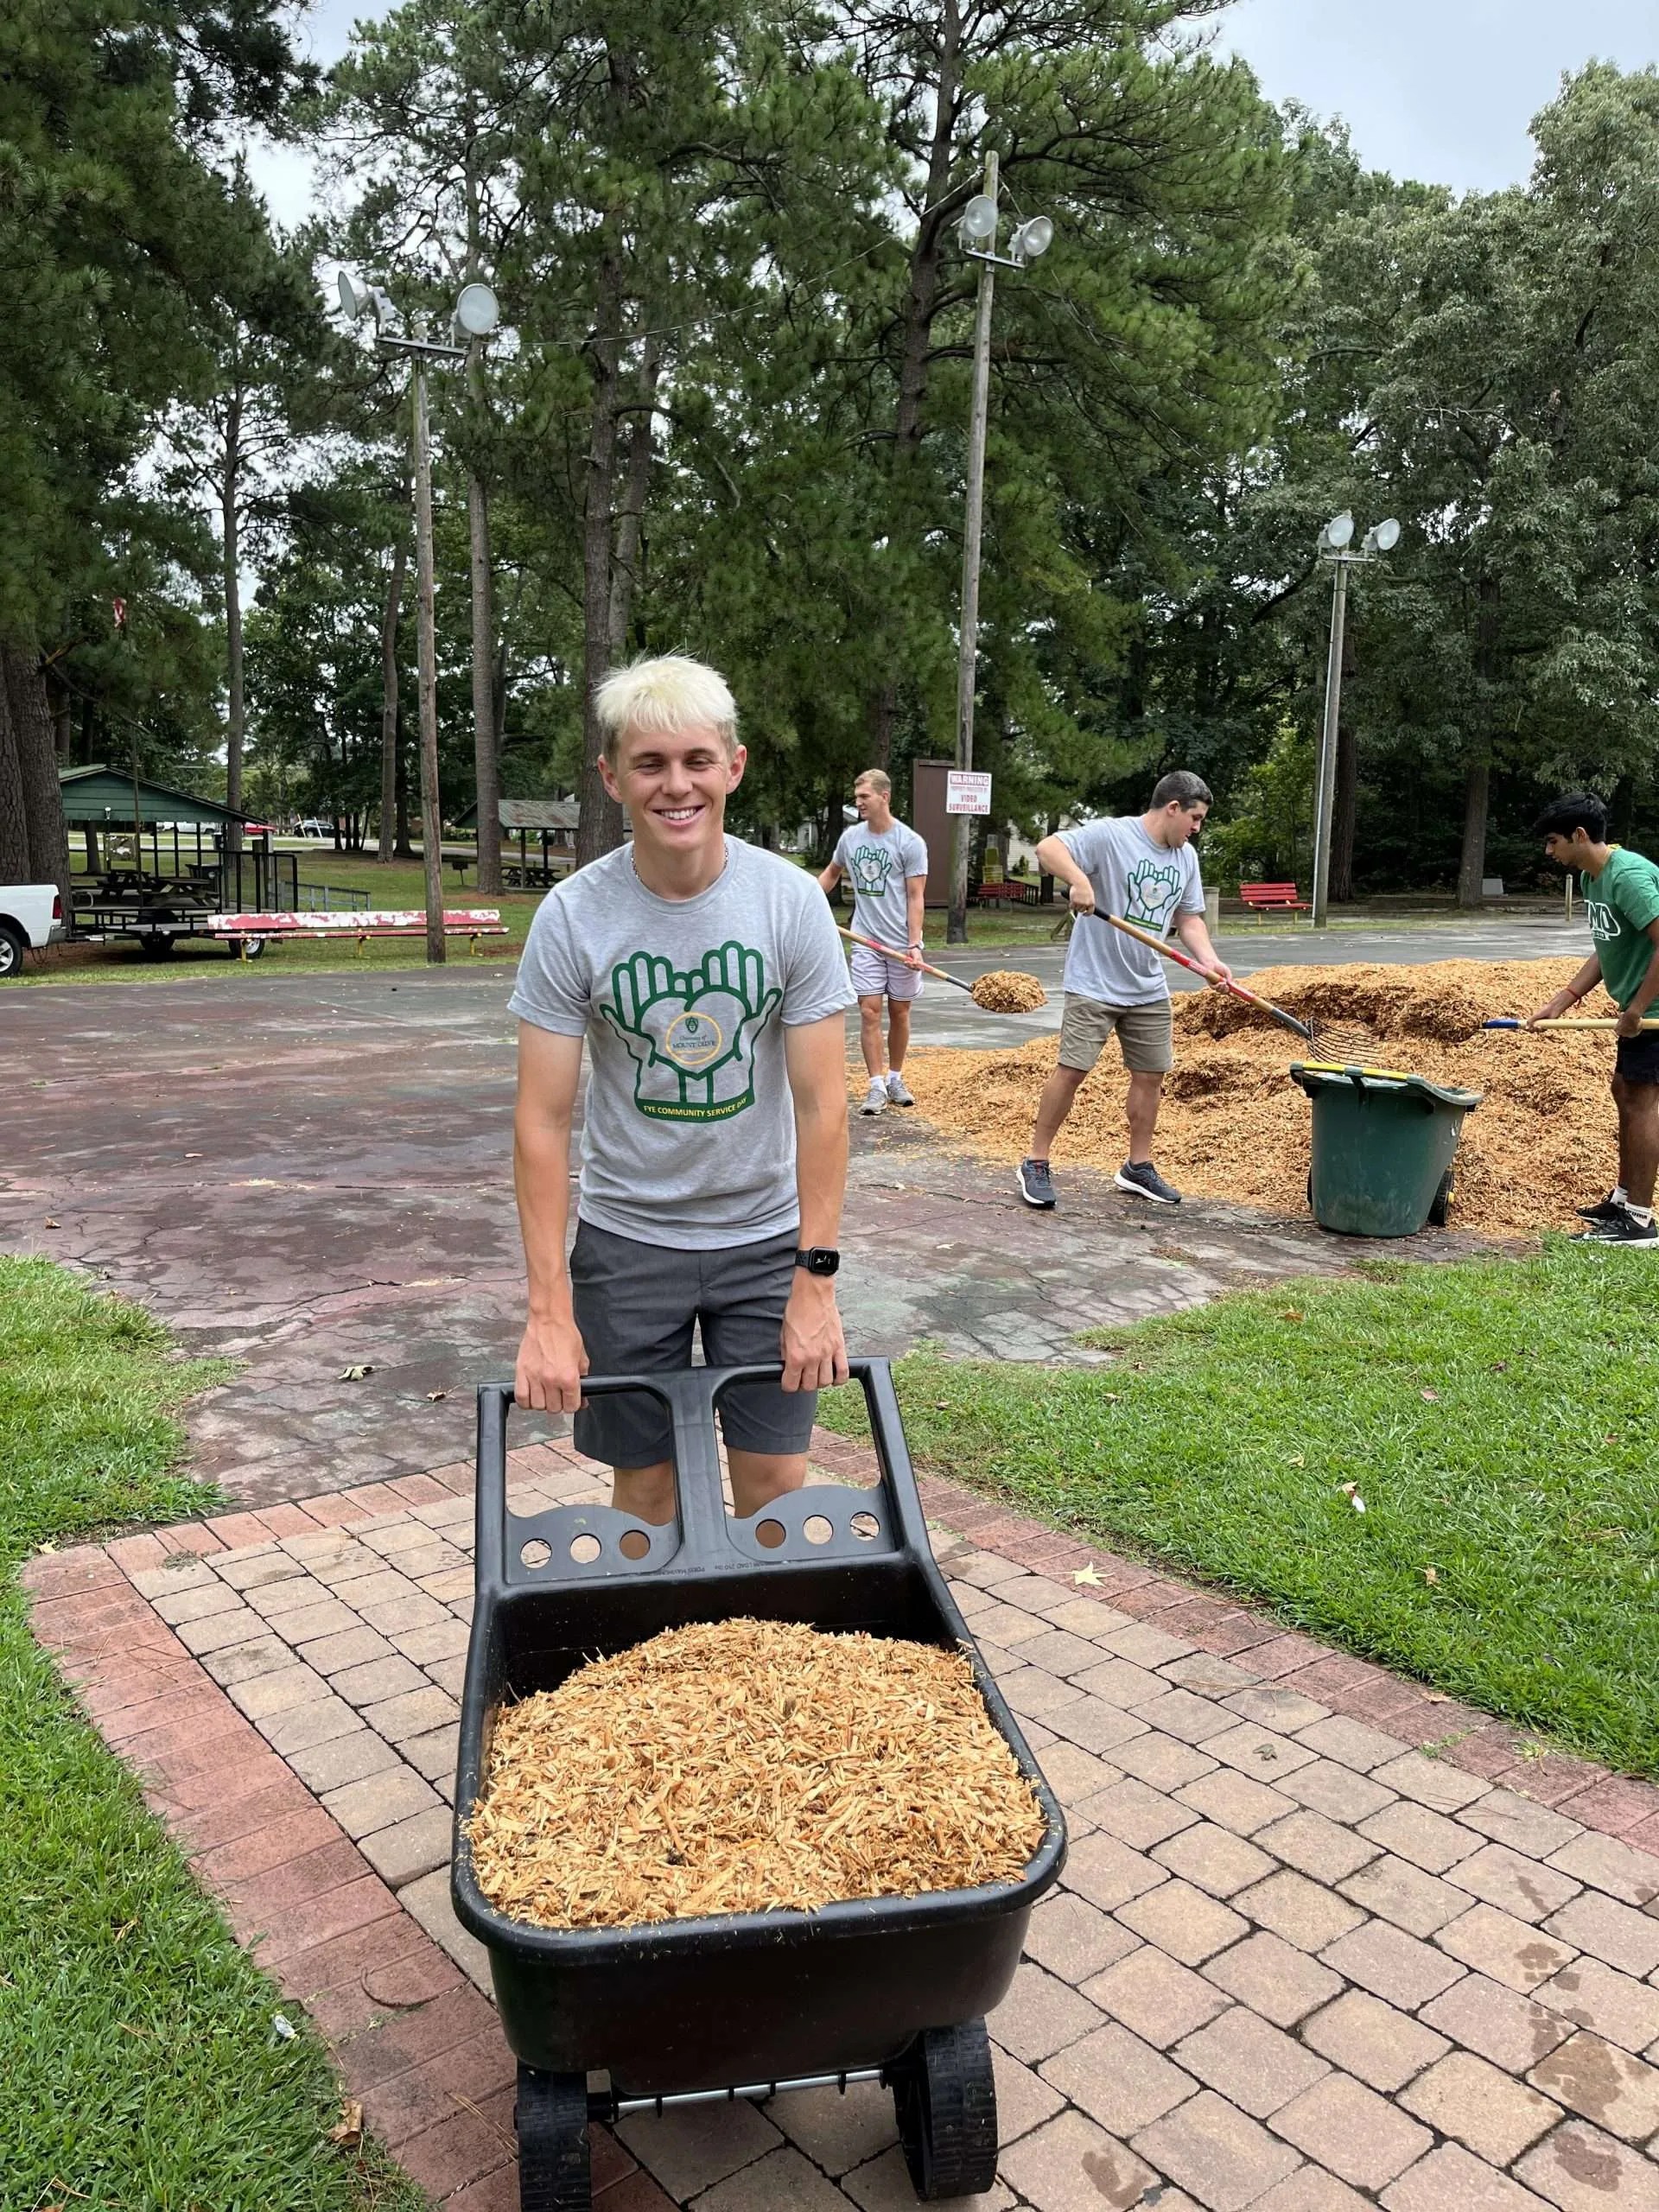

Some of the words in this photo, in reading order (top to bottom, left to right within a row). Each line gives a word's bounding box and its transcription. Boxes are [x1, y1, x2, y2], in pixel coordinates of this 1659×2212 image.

[950, 774, 988, 785] WARNING
[961, 794, 977, 803] VIDEO
[949, 803, 988, 812] SURVEILLANCE
[658, 1107, 705, 1117] COMMUNITY
[707, 1104, 735, 1116] SERVICE
[736, 1096, 747, 1109] DAY
